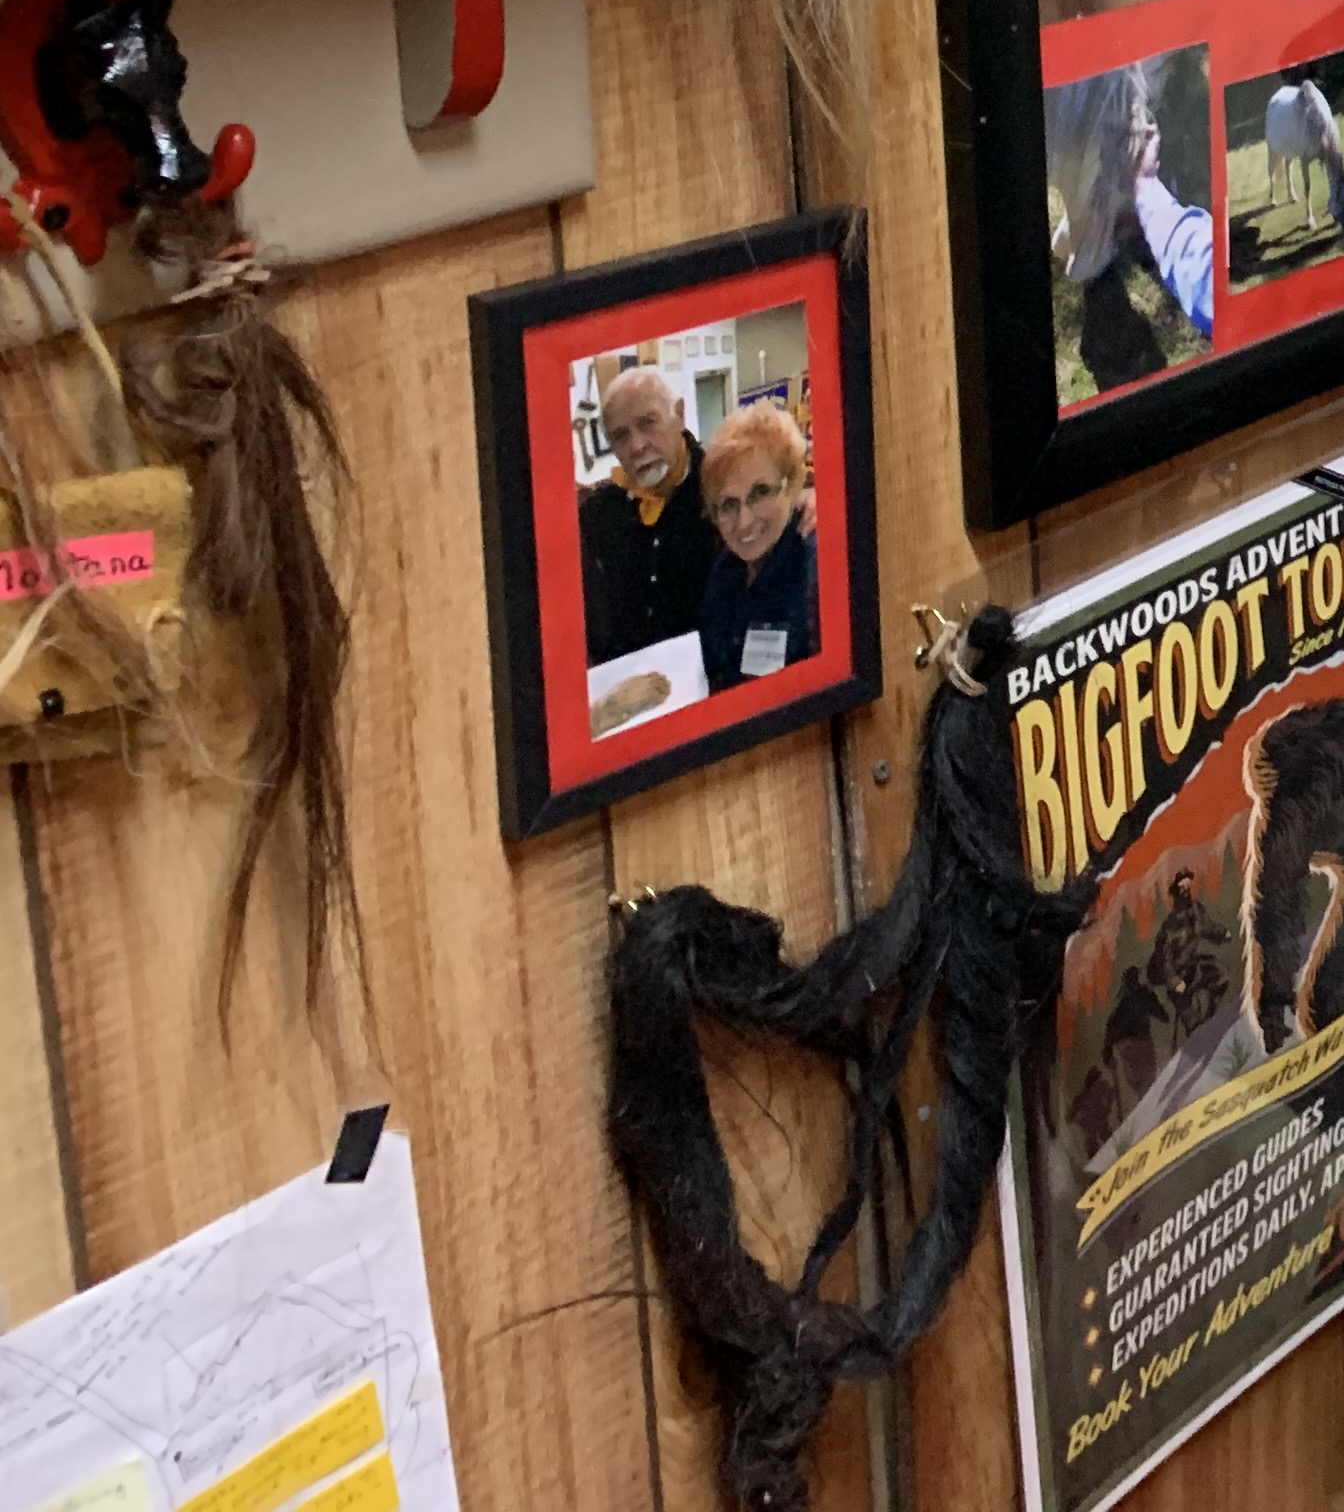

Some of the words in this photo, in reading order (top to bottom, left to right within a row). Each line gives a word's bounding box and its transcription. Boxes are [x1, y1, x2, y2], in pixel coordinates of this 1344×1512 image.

[1007, 567, 1219, 705] BACKWOODS
[1288, 629, 1334, 666] Since
[1013, 577, 1269, 894] BIGFOOT
[1157, 1119, 1194, 1156] the
[1199, 1047, 1311, 1129] Sasquatch
[1106, 1157, 1248, 1296] EXPERIENCED
[1252, 1097, 1325, 1176] GUIDES
[1108, 1196, 1249, 1334] GUARANTEED
[1066, 1379, 1133, 1464] Book
[1138, 1330, 1199, 1399] Your
[1202, 1224, 1335, 1348] Adventure
[1111, 1231, 1250, 1374] EXPEDITIONS
